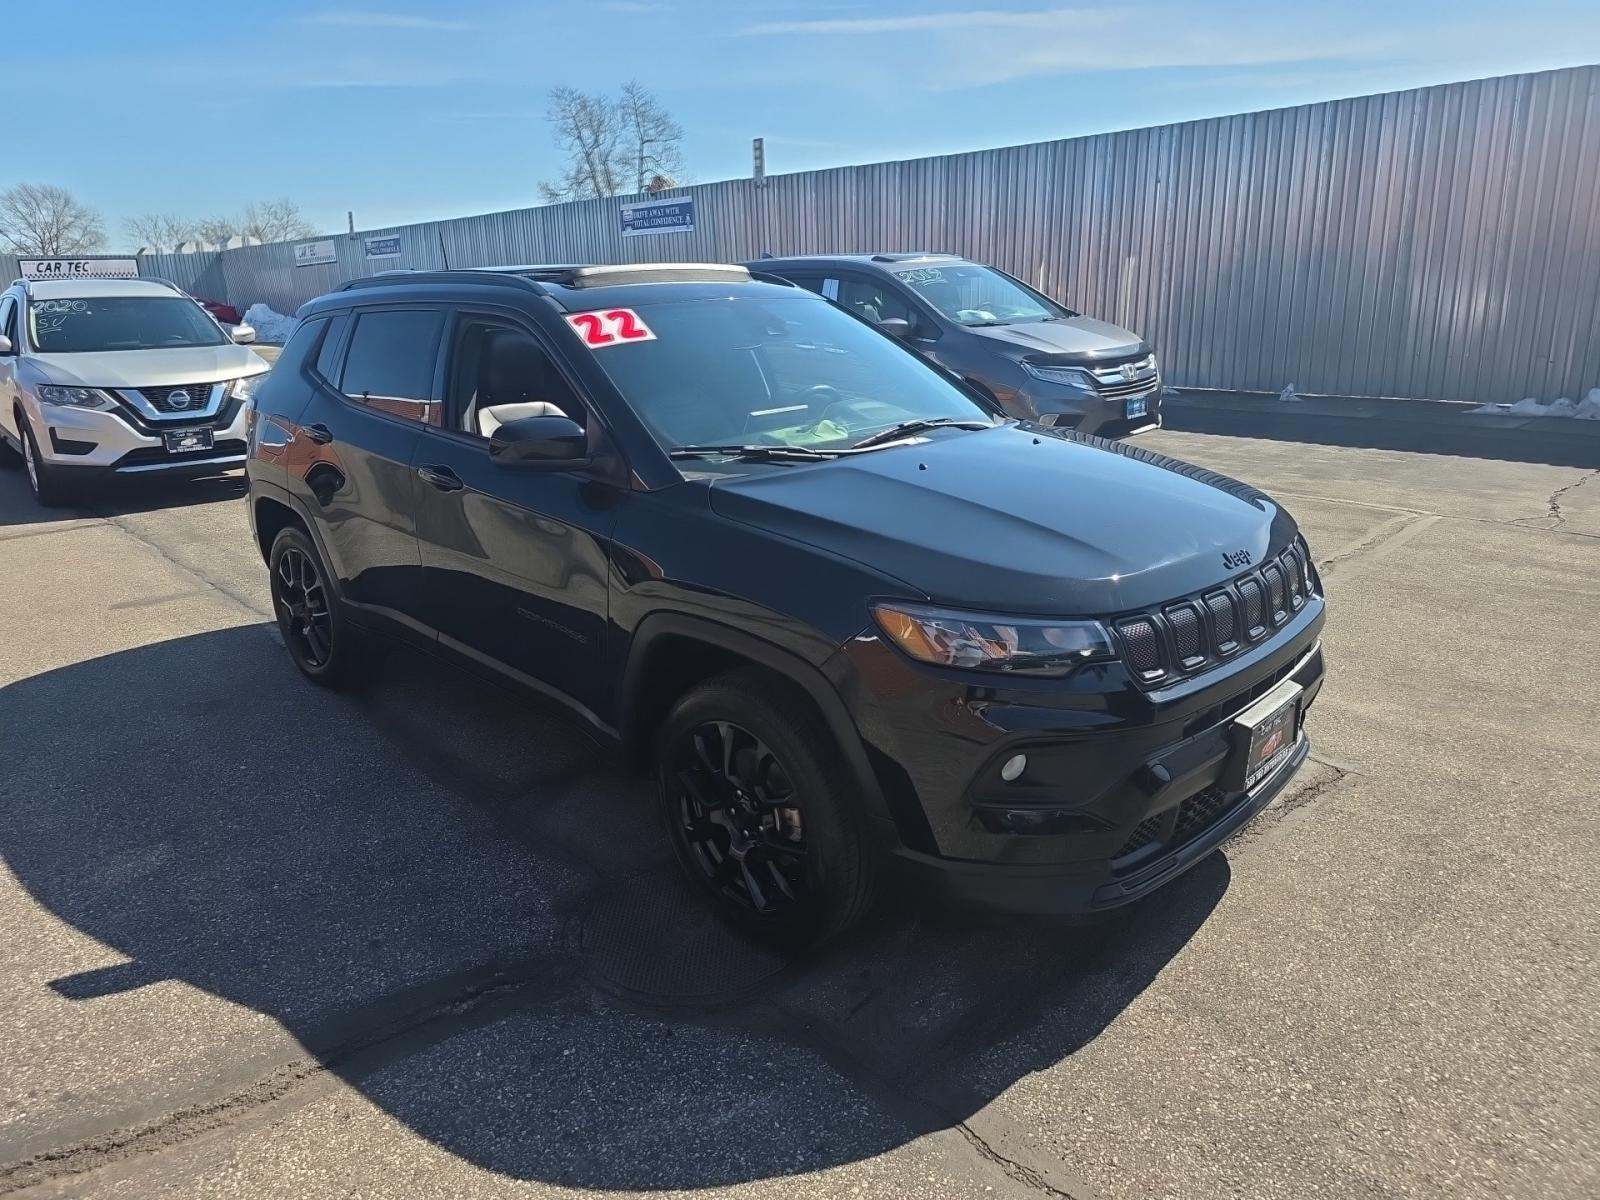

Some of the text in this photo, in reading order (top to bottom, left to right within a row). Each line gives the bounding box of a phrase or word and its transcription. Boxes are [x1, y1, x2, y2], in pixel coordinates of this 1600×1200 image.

[649, 209, 664, 217] AWAY
[634, 219, 650, 228] TOTAL
[36, 262, 90, 273] CAR TEC
[33, 300, 88, 314] 2020
[572, 311, 648, 344] 22
[1222, 550, 1251, 570] Jeep
